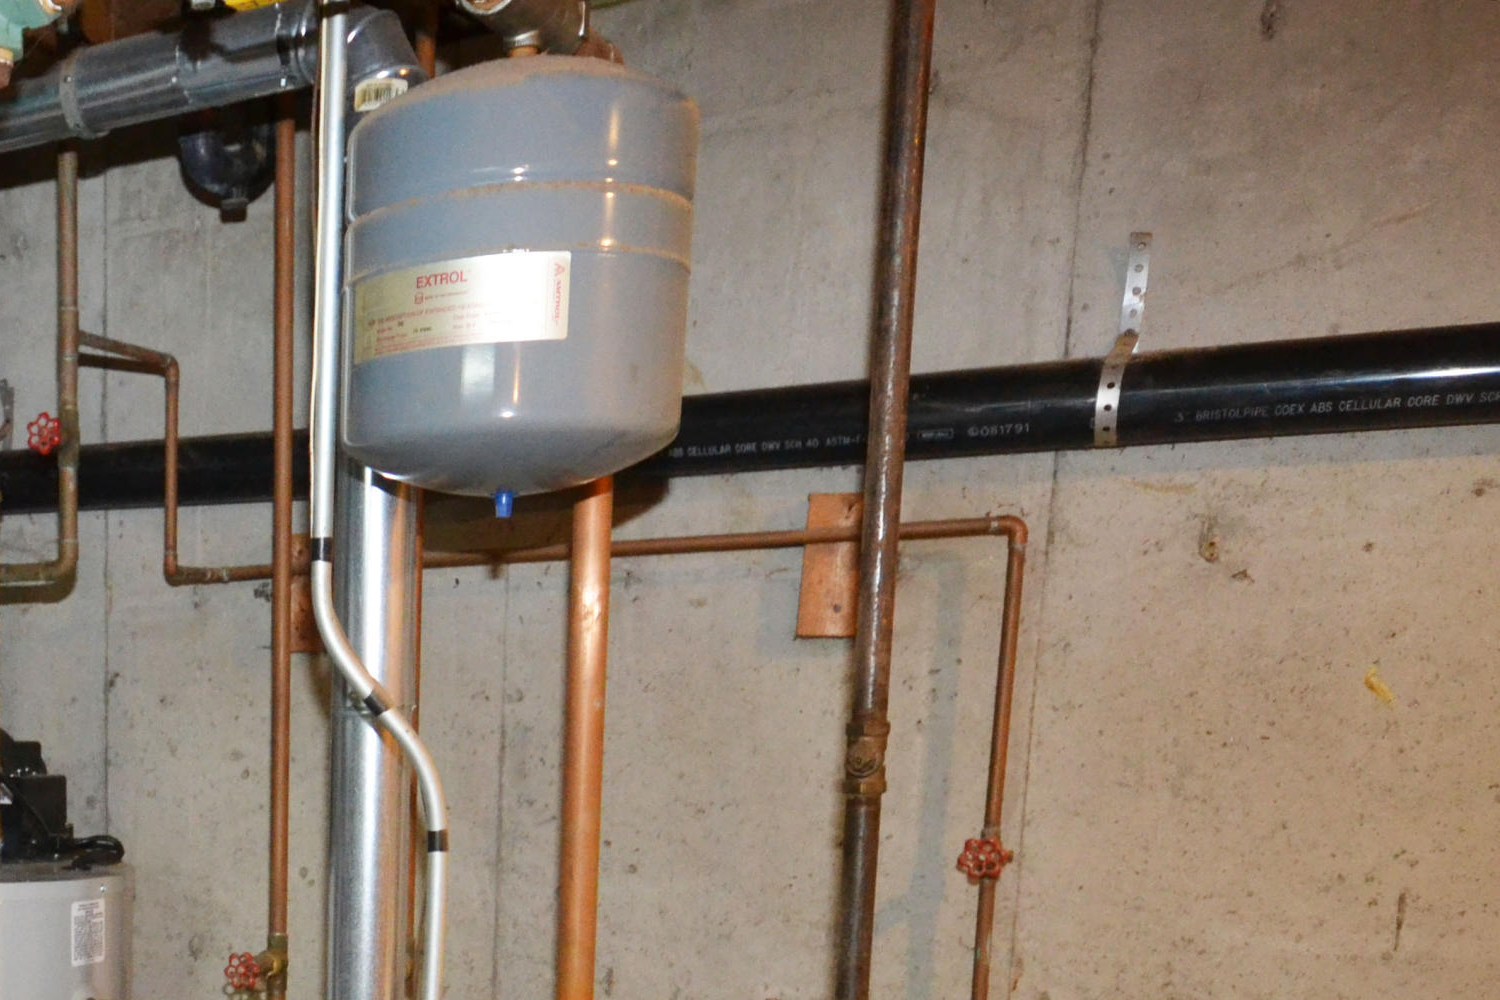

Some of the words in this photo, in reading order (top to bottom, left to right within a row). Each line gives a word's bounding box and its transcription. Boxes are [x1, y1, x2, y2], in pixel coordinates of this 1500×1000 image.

[416, 270, 468, 289] EXTROL
[1310, 402, 1333, 413] ABS
[1339, 397, 1401, 412] CELLULAR
[1407, 394, 1440, 407] CORE
[1446, 392, 1476, 405] DWV
[687, 444, 732, 457] CELLULAR
[735, 441, 757, 454] CORE
